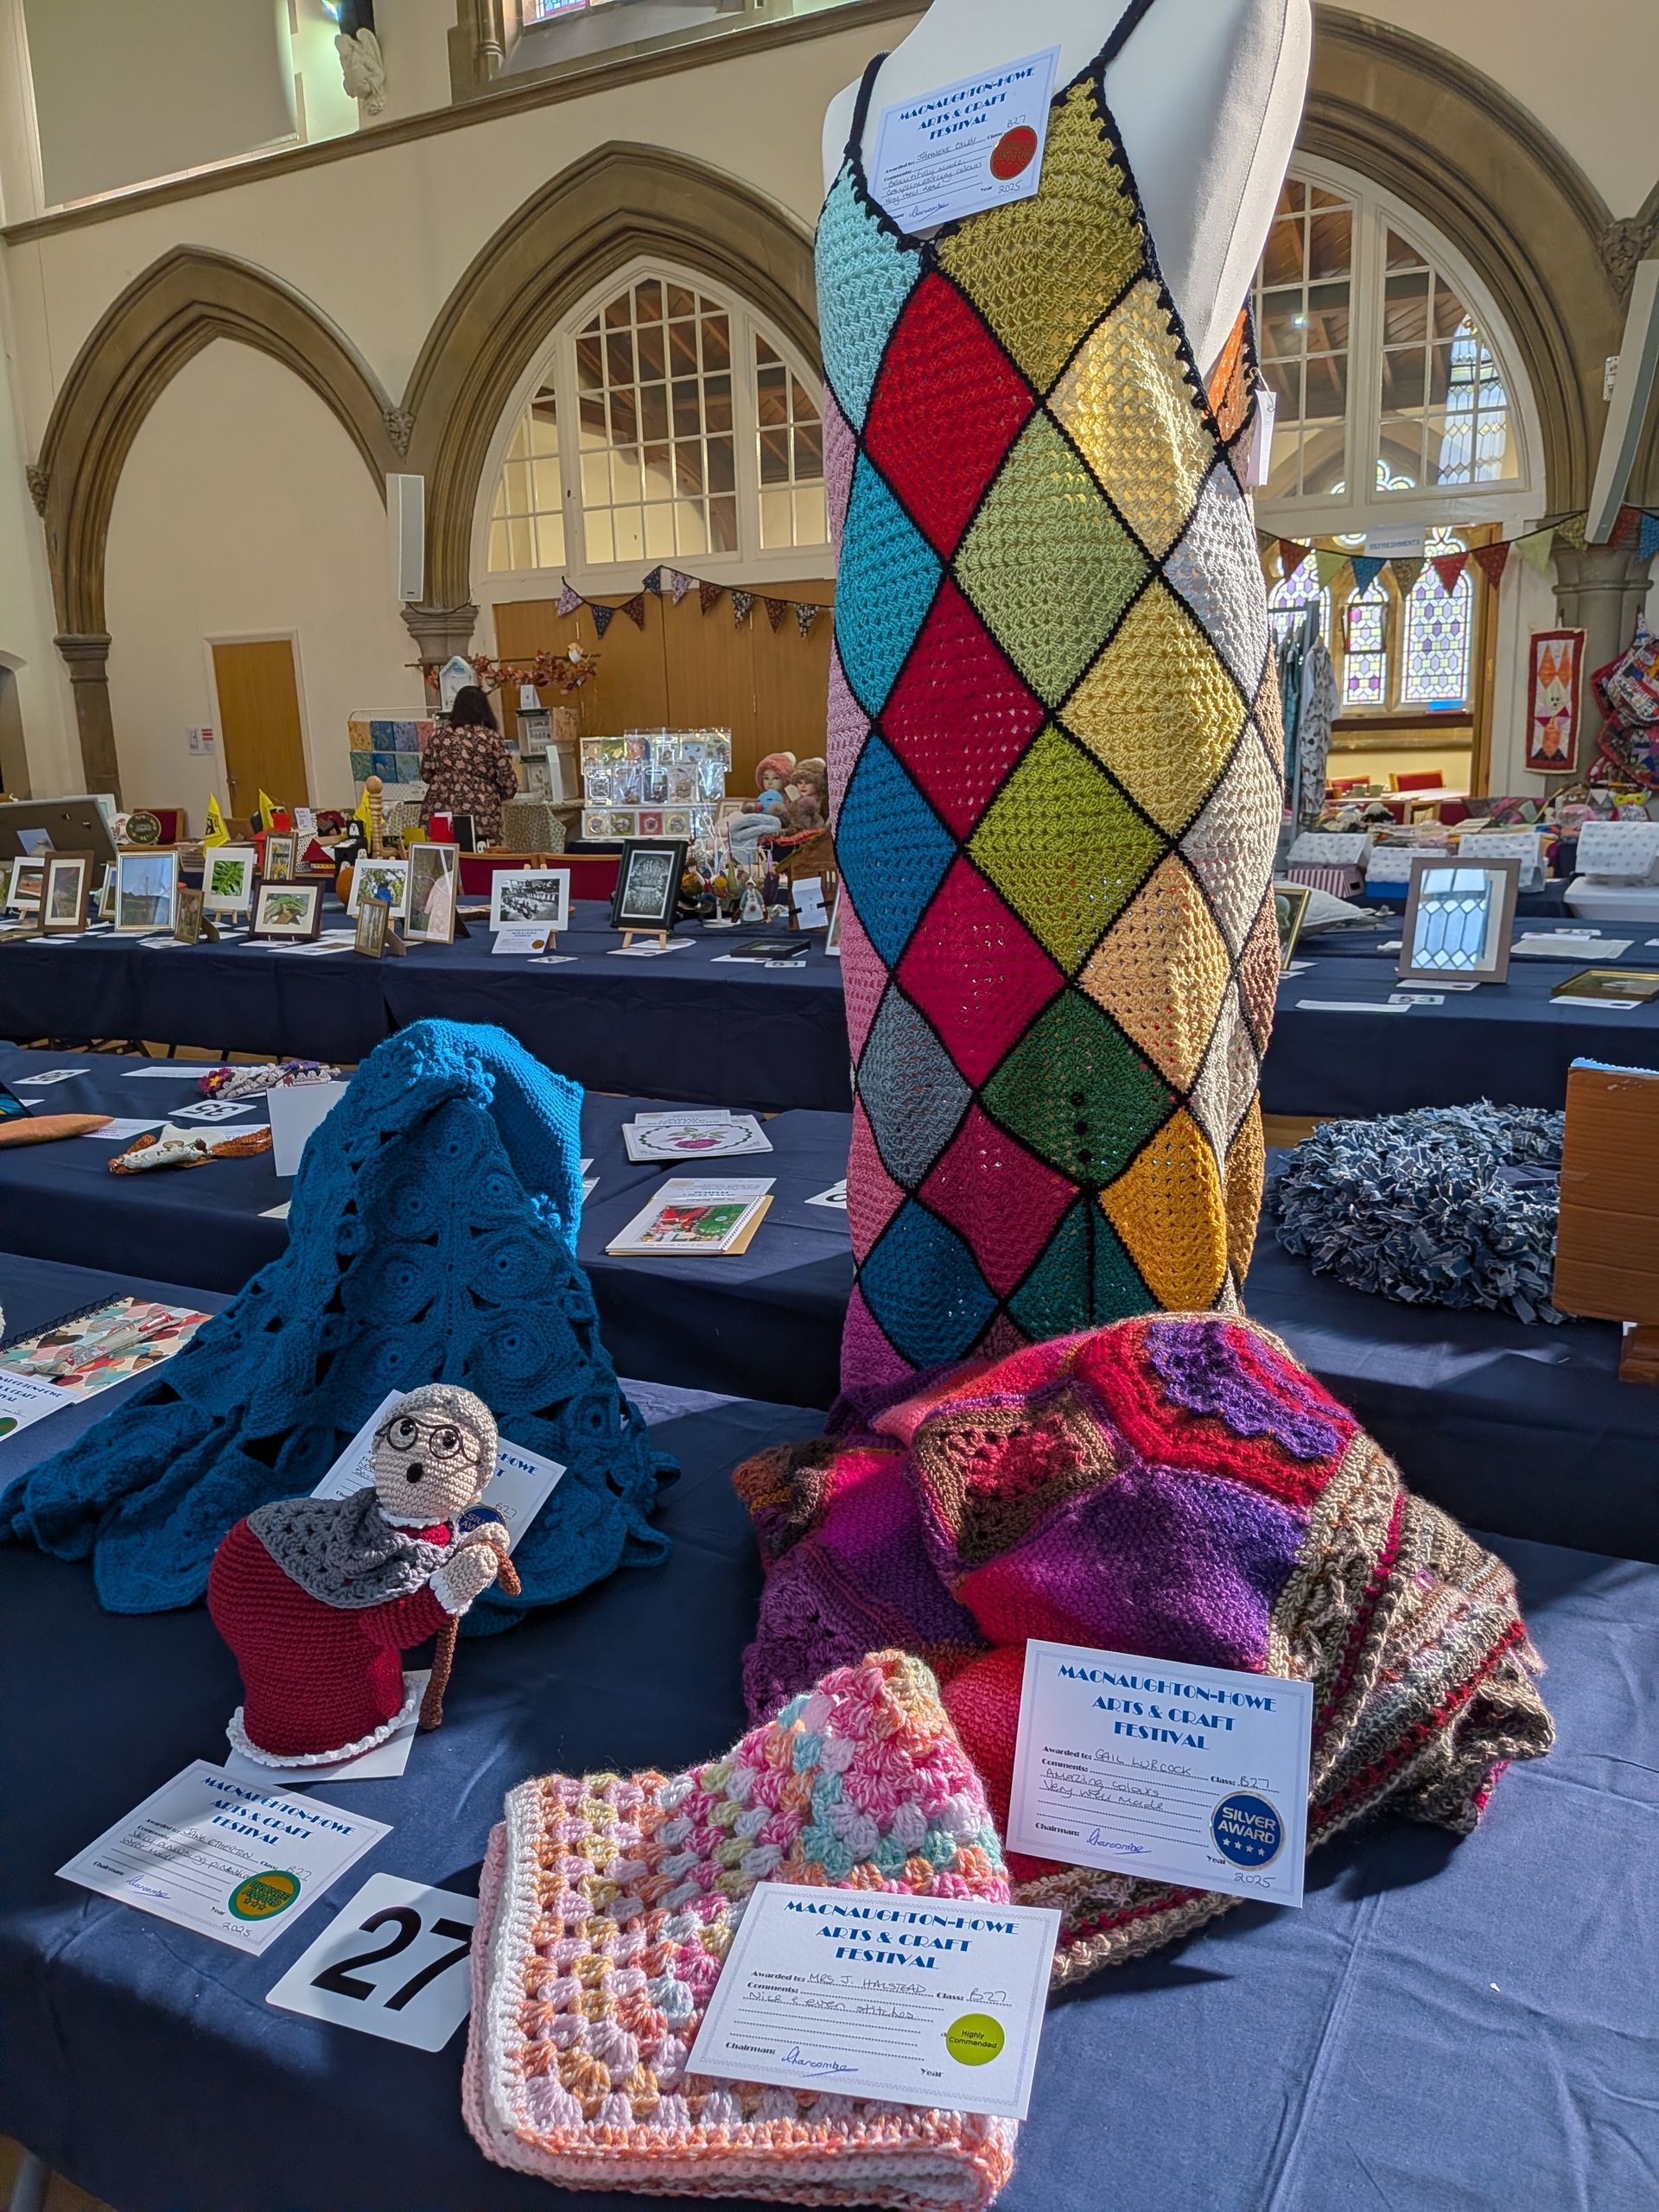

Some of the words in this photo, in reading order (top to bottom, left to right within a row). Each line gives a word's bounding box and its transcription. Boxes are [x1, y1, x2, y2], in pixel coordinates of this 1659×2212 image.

[899, 67, 1035, 122] MACNAUGHTON-HOWE
[918, 112, 950, 130] ARTS
[951, 107, 962, 119] &
[964, 92, 1007, 114] CRAFT
[930, 113, 988, 140] FESTIVAL
[998, 180, 1023, 194] 2025
[184, 1103, 238, 1117] 35
[1058, 1664, 1277, 1713] MACNAUGHTON-HOWE
[1092, 1695, 1143, 1716] ARTS
[1148, 1705, 1162, 1719] &
[1168, 1708, 1236, 1731] CRAFT
[1114, 1720, 1210, 1751] FESTIVAL
[1041, 1758, 1089, 1772] Comments:
[1042, 1745, 1080, 1758] Awarded
[1095, 1748, 1124, 1764] GAIL
[1211, 1776, 1236, 1786] Class:
[1240, 1776, 1269, 1789] B27
[1044, 1779, 1072, 1798] Very
[201, 1777, 357, 1837] MACNAUGHTON-HOWE
[145, 1818, 173, 1831] Awarded
[182, 1827, 207, 1842] JANE
[209, 1799, 250, 1816] ARTS
[248, 1811, 261, 1822] &
[262, 1816, 315, 1840] CRAFT
[212, 1815, 281, 1846] FESTIVAL
[1035, 1822, 1080, 1836] Chairman:
[1222, 1807, 1276, 1831] SILVER
[1217, 1819, 1275, 1845] AWARD
[1206, 1855, 1226, 1865] Year
[250, 1880, 292, 1902] BRONZE
[1234, 1872, 1276, 1888] 2025
[242, 1888, 282, 1908] AWARD
[210, 1906, 226, 1916] Year
[784, 1901, 1020, 1936] MACNAUGHTON-HOWE
[221, 1922, 252, 1937] 2025
[816, 1925, 872, 1942] ARTS
[876, 1931, 892, 1943] &
[899, 1934, 972, 1952] CRAFT
[309, 1905, 475, 2012] 27
[835, 1947, 939, 1970] FESTIVAL
[747, 1981, 799, 1993] Comments:
[751, 1970, 792, 1981] Awarded
[809, 1973, 835, 1984] MRS
[863, 1979, 926, 1993] HALSTEAD
[937, 1992, 964, 2001] Class:
[969, 1987, 1007, 2003] B27
[749, 1992, 782, 2002] Nice
[805, 1999, 847, 2010] even
[949, 2036, 997, 2049] Commended
[962, 2030, 985, 2040] Highly
[725, 2041, 775, 2055] Chairman:
[920, 2068, 943, 2077] Year
